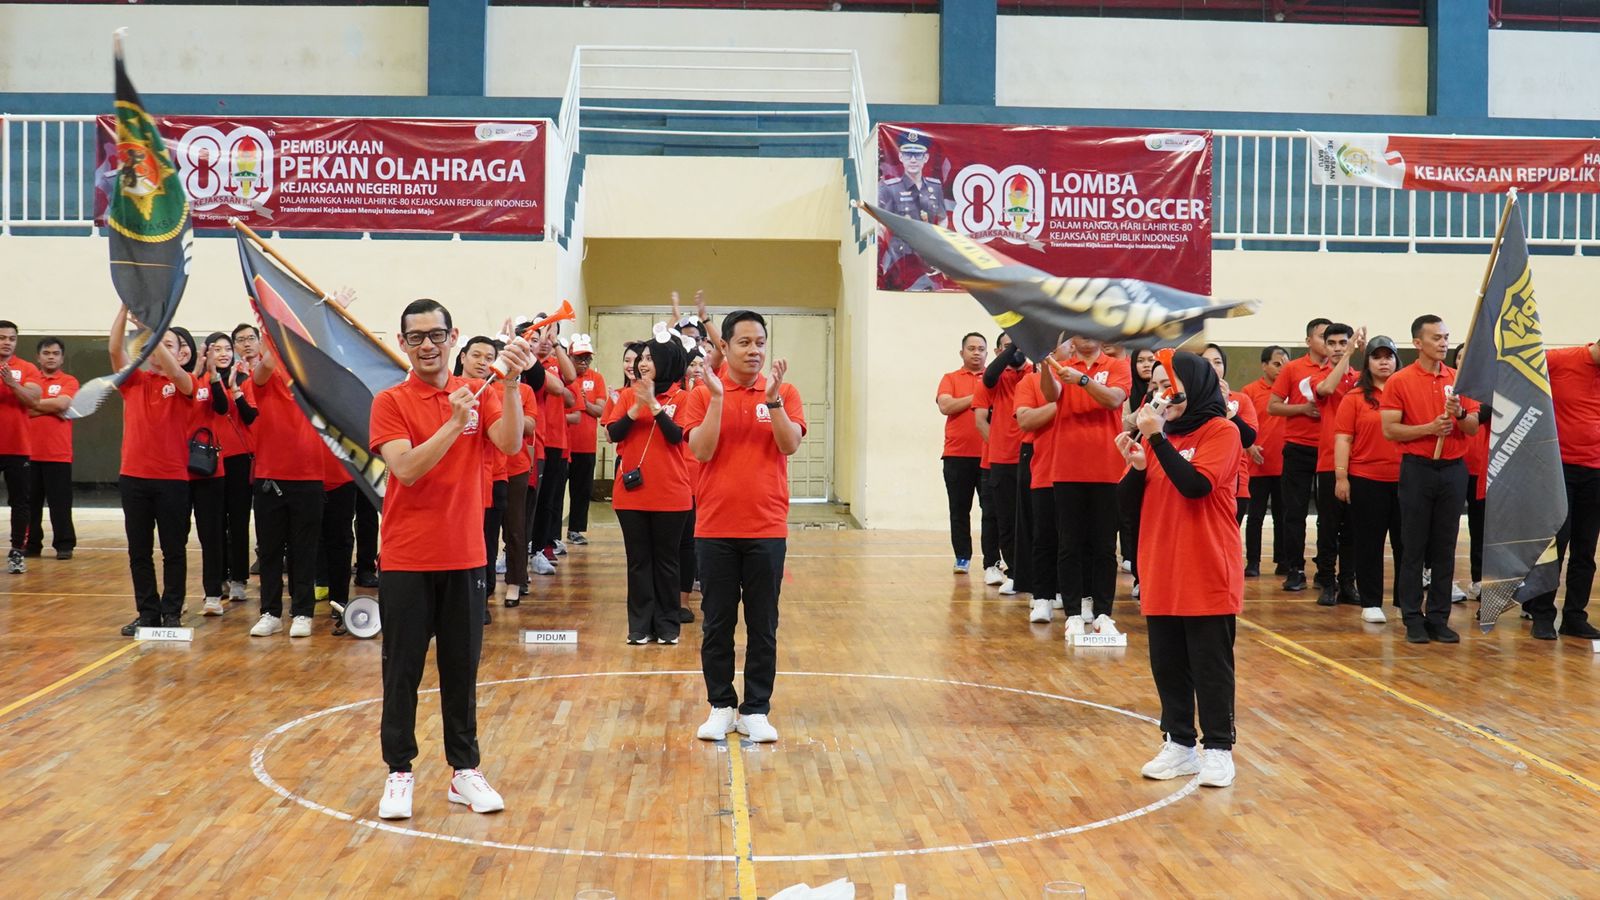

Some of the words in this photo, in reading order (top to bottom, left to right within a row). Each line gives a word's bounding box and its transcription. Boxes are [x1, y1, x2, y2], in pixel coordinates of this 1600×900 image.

[280, 140, 383, 155] PEMBUKAAN
[280, 156, 368, 179] PEKAN
[375, 157, 526, 182] OLAHRAGA
[1414, 165, 1512, 182] KEJAKSAAN
[1516, 167, 1596, 182] REPUBLIK
[280, 182, 353, 194] KEJAKSAAN
[356, 183, 401, 195] NEGERI
[404, 183, 437, 195] BATU
[1051, 172, 1138, 195] LOMBA
[280, 196, 308, 204] DALAM
[310, 196, 342, 205] RANGKA
[343, 197, 362, 205] HARI
[363, 197, 387, 205] LAHIR
[388, 197, 410, 206] KE-80
[411, 198, 455, 207] KEJAKSAAN
[457, 198, 494, 207] REPUBLIK
[495, 199, 537, 208] INDONESIA
[1050, 196, 1105, 219] MINI
[1111, 198, 1205, 220] SOCCER
[323, 206, 356, 215] Kejaksaan
[358, 207, 382, 215] Menuju
[417, 208, 435, 216] Maju
[1050, 220, 1081, 230] DALAM
[1082, 221, 1118, 230] RANGKA
[1120, 222, 1140, 231] HARI
[1143, 222, 1167, 231] LAHIR
[1169, 223, 1193, 232] KE-80
[1050, 232, 1098, 241] KEJAKSAAN
[1100, 232, 1140, 242] REPUBLIK
[1142, 233, 1188, 243] INDONESIA
[151, 630, 178, 638] INTEL
[536, 633, 567, 641] PIDUM
[1083, 636, 1117, 644] PIDSUS
